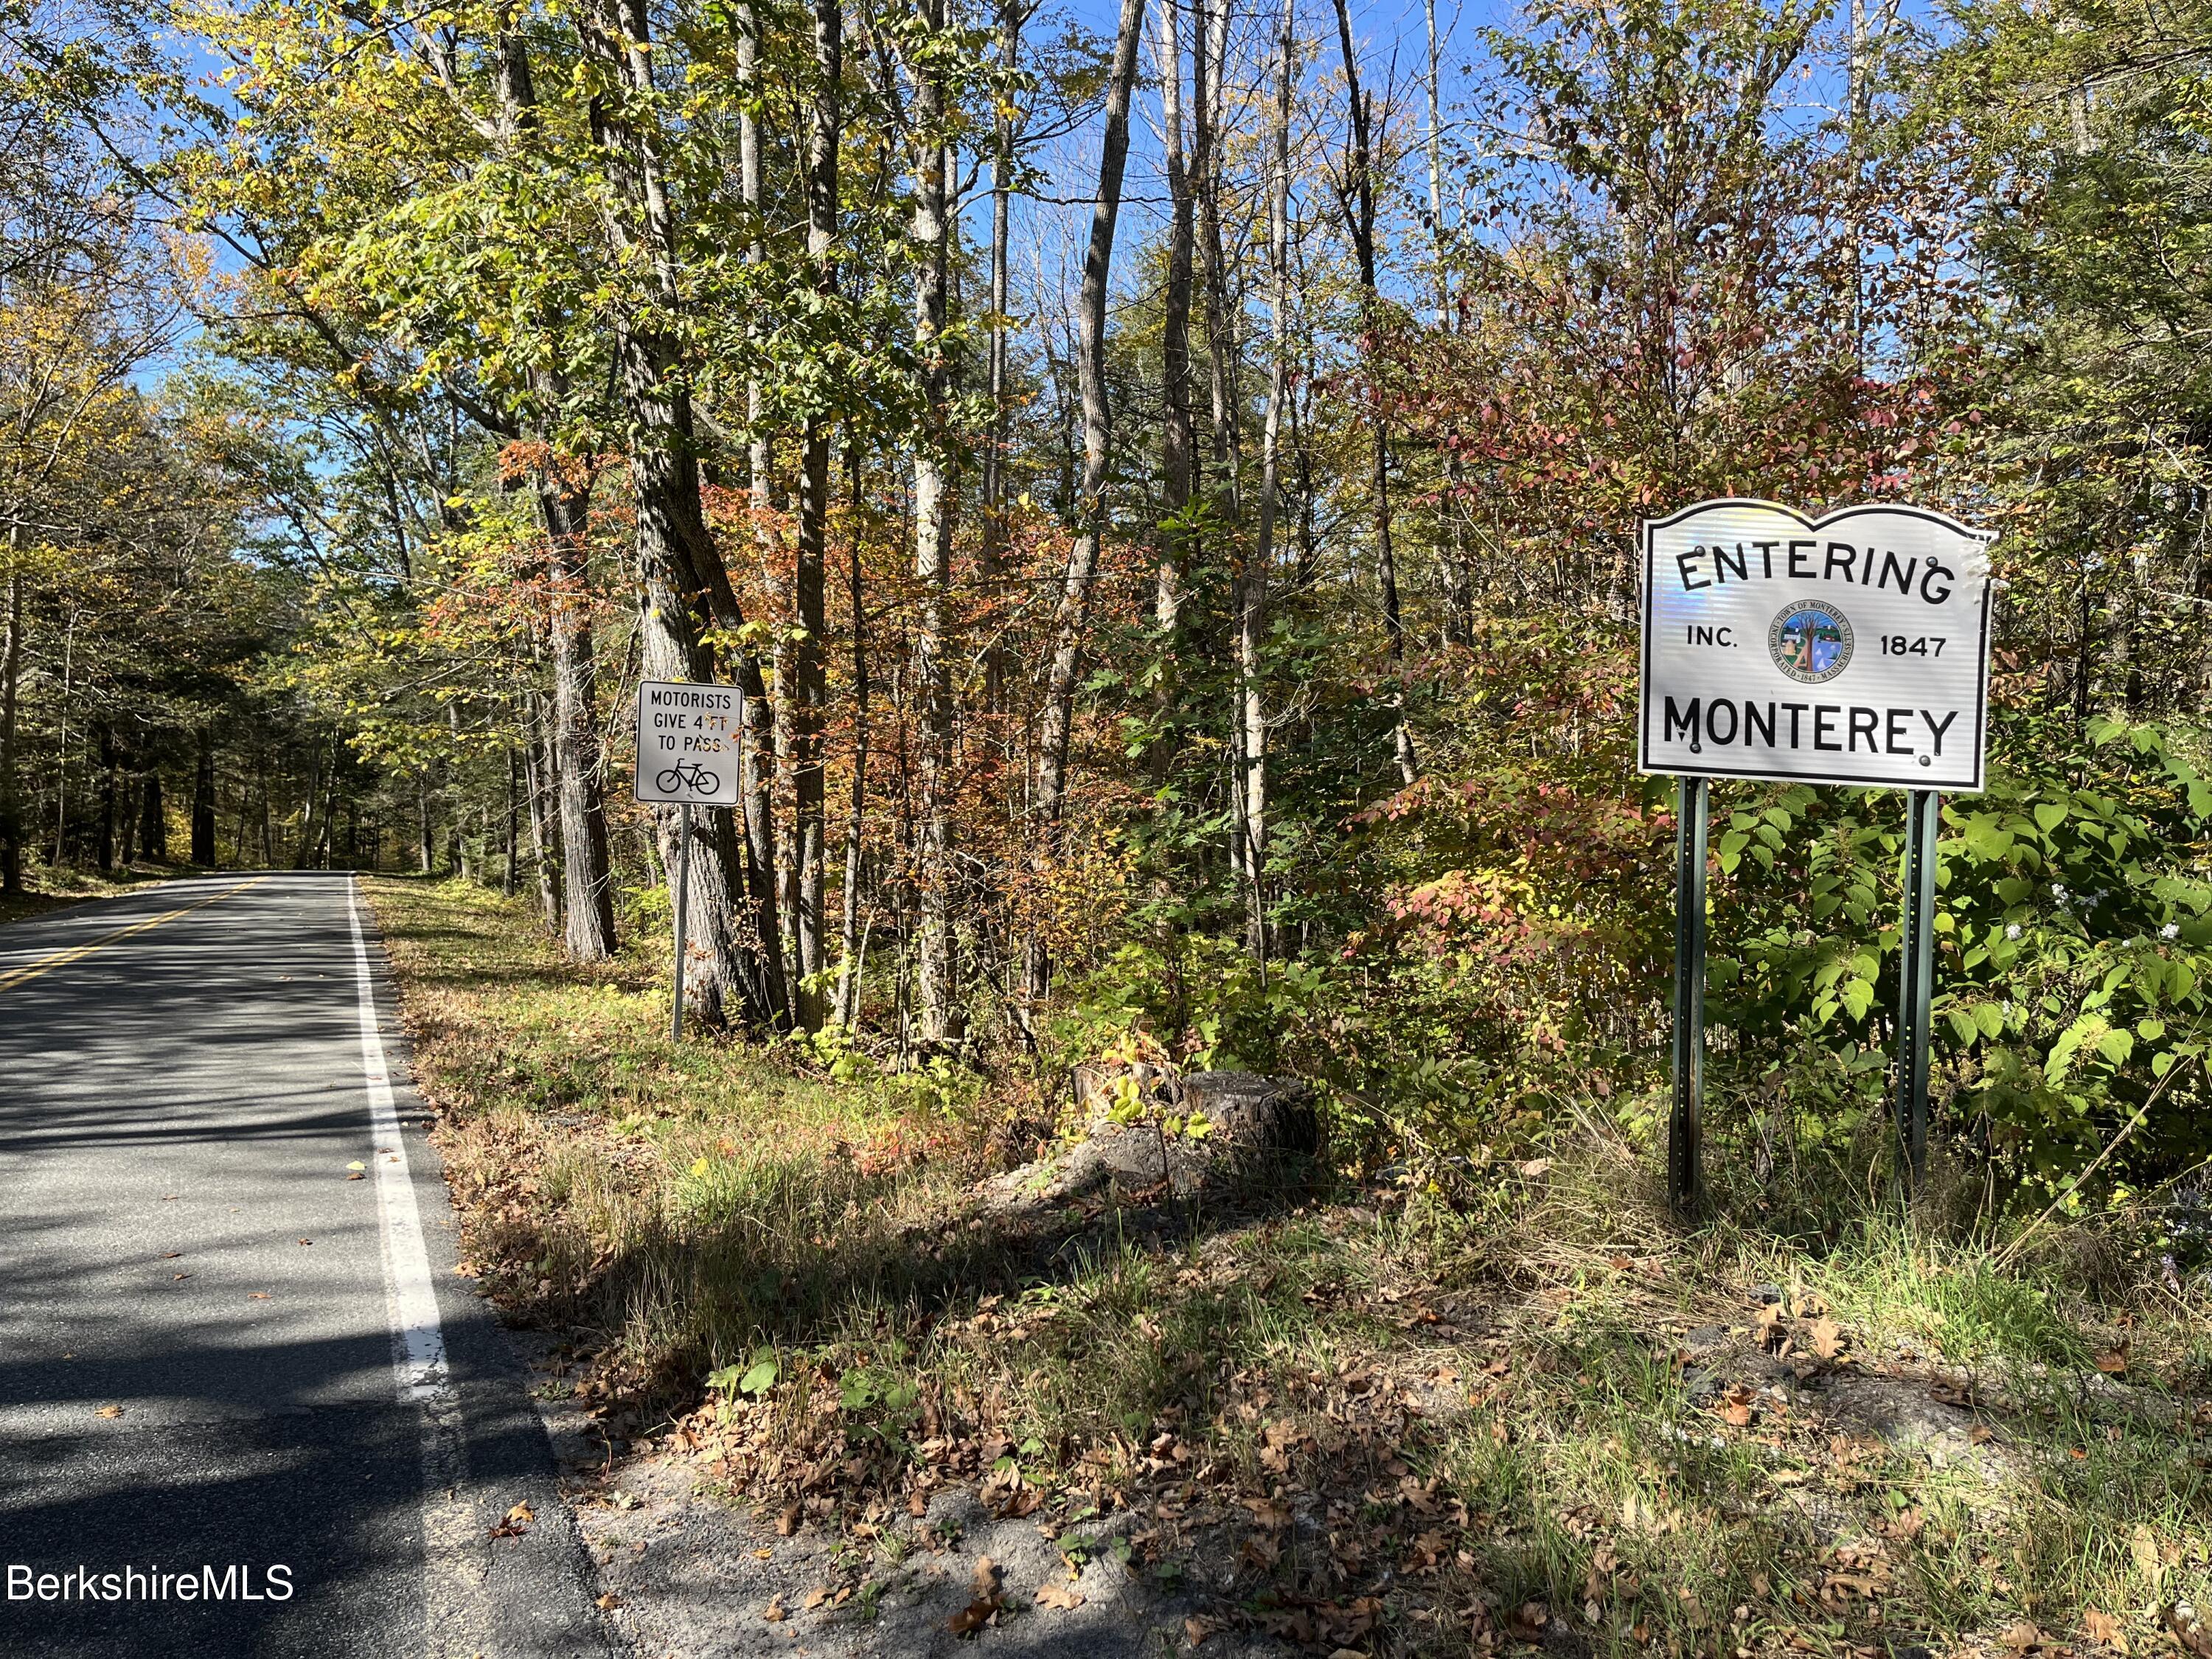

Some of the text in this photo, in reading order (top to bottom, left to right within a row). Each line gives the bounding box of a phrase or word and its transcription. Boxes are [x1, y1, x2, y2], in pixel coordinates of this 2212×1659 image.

[1676, 540, 1955, 605] ENTERING
[1778, 605, 1796, 622] TOWN
[1810, 601, 1846, 625] MONTEREY
[1687, 625, 1738, 647] INC.
[1881, 636, 1947, 657] 1847
[1770, 625, 1797, 677] INCORPORATED
[1801, 673, 1816, 682] 1847
[651, 690, 731, 709] MOTORISTS
[655, 713, 728, 731] GIVE 4 FT
[1664, 696, 1959, 756] MONTEREY
[658, 735, 721, 753] TO PASS
